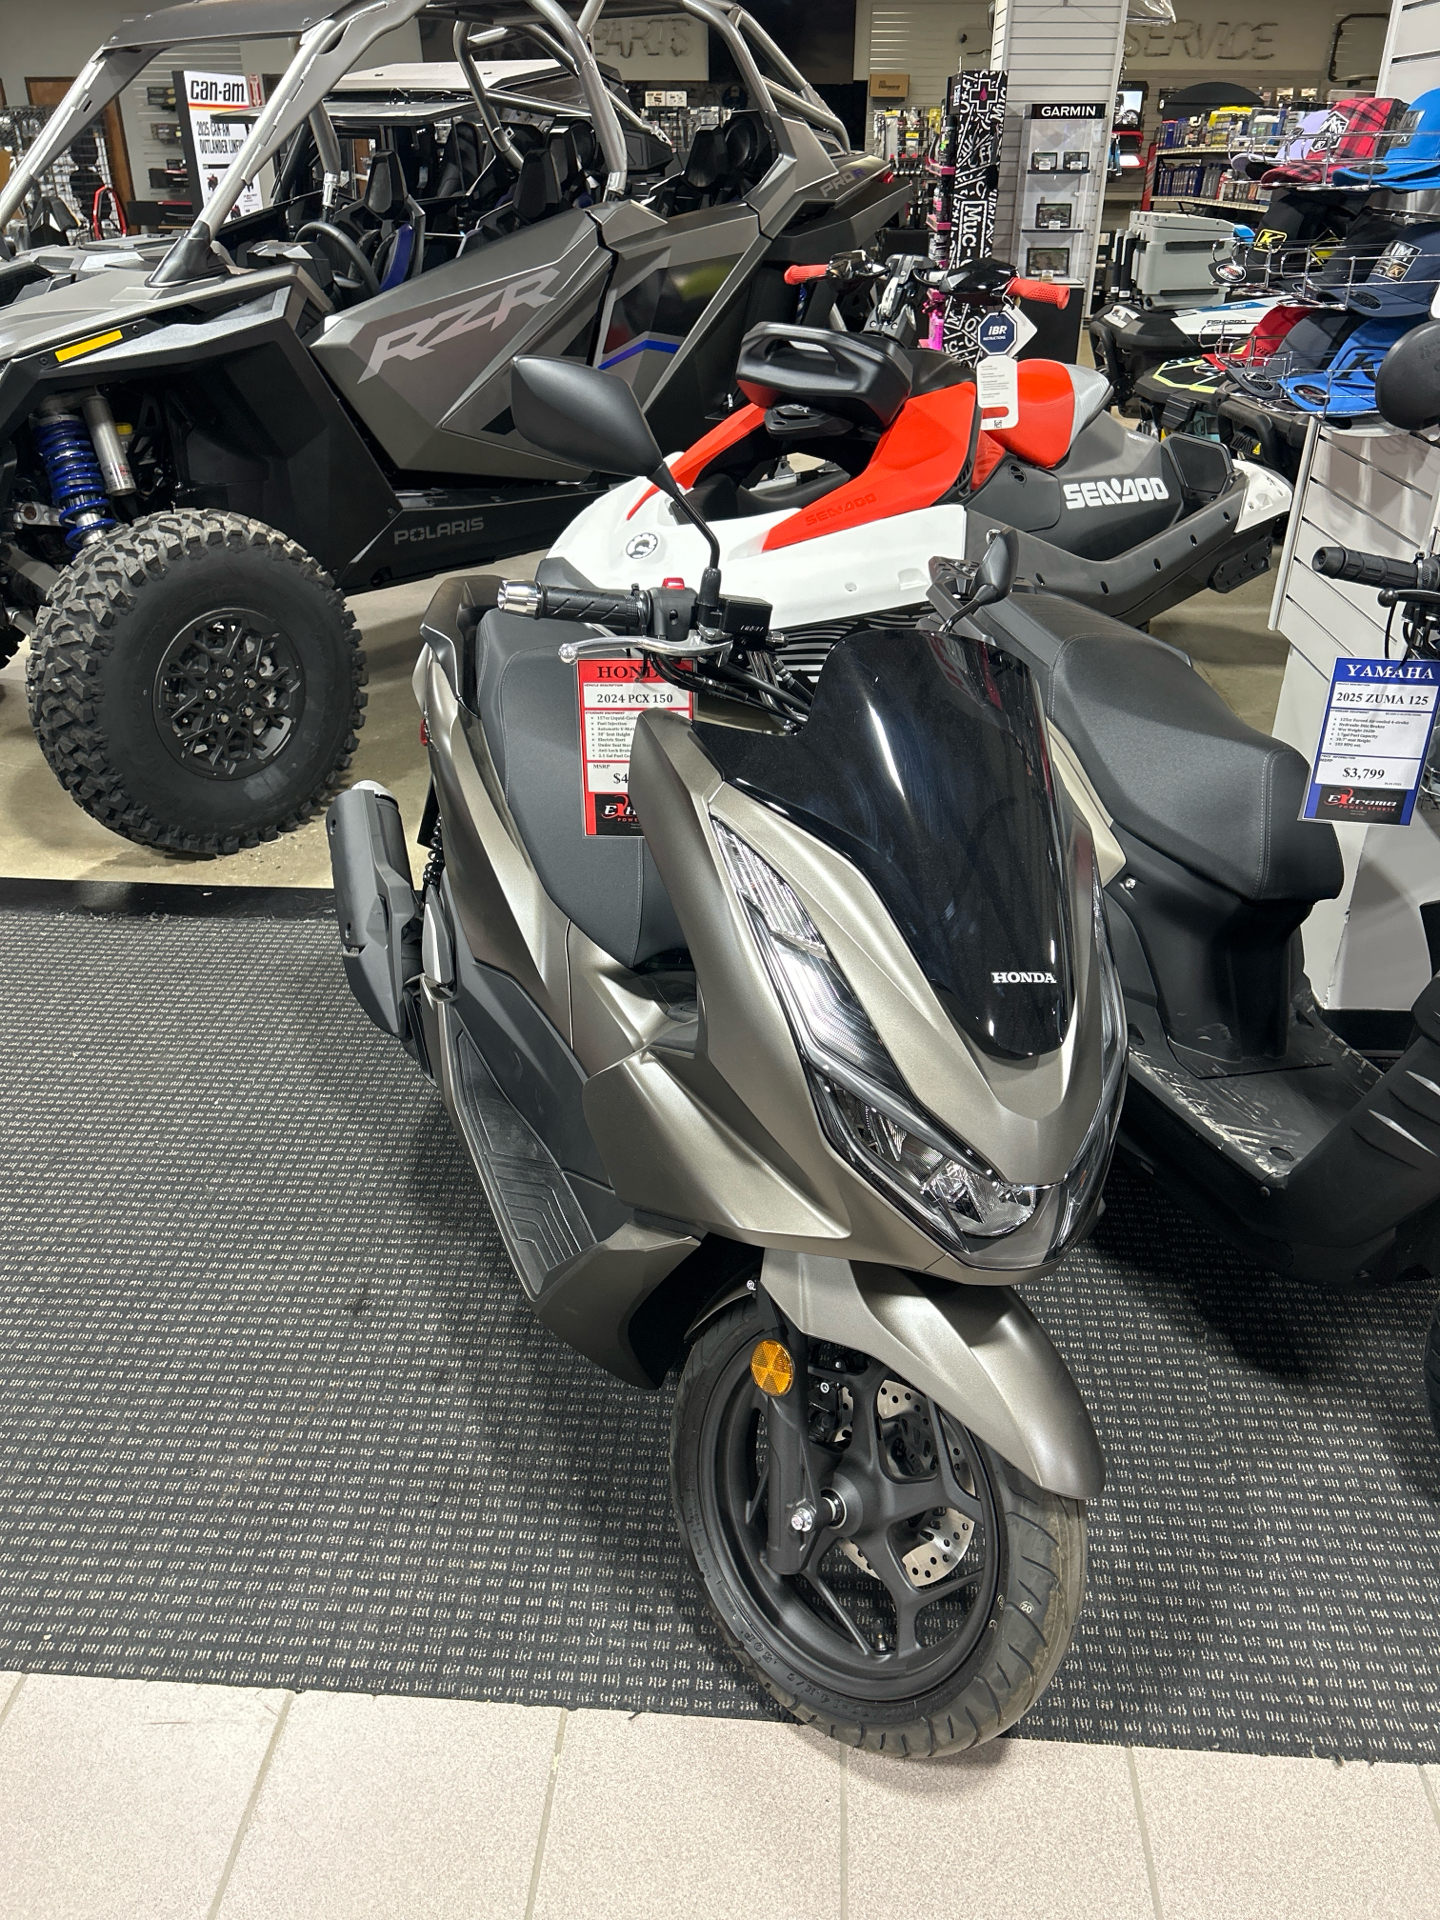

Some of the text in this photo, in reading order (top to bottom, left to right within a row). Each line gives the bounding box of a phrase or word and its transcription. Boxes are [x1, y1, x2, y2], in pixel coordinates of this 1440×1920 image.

[1125, 19, 1279, 60] SERVICE
[1041, 105, 1096, 117] GARMIN
[196, 121, 210, 136] 2025
[199, 139, 229, 154] OUTLANDER
[357, 268, 560, 384] RZR
[393, 517, 485, 545] POLARIS
[597, 666, 658, 679] HOND
[1346, 664, 1434, 680] YAMAHA
[596, 694, 673, 703] 2024 PCX 150
[1336, 692, 1429, 705] 2025 ZUMA 125
[613, 773, 629, 784] $4
[1342, 767, 1385, 779] $3,799
[991, 971, 1057, 984] HONDA
